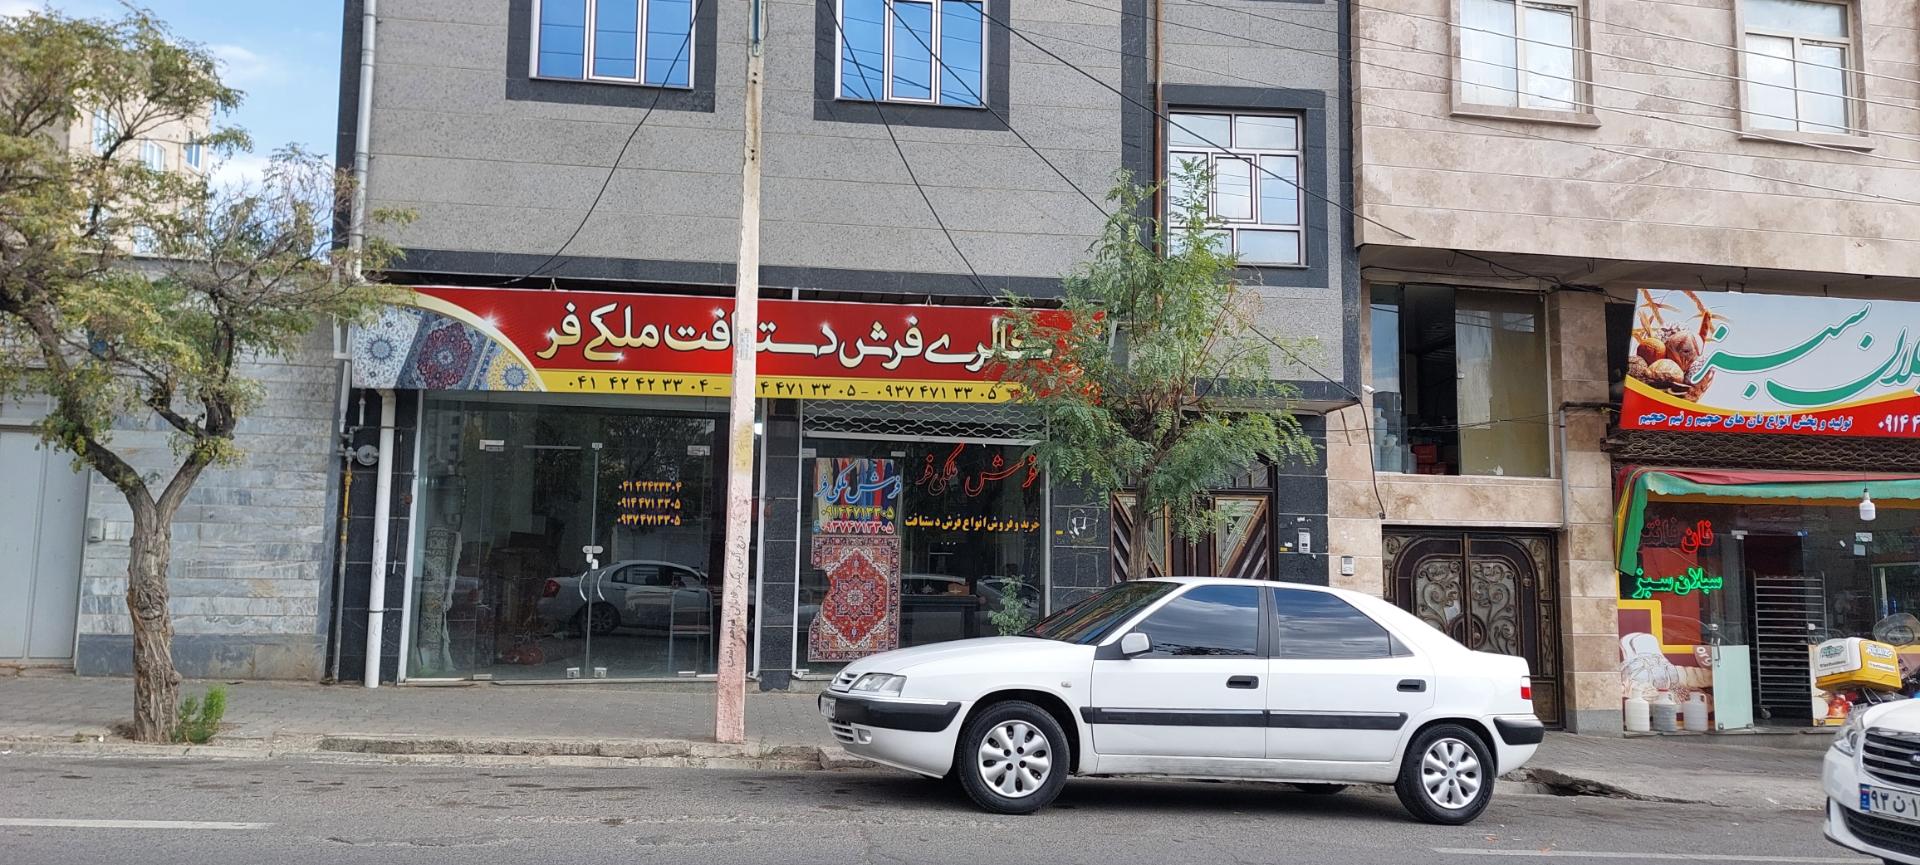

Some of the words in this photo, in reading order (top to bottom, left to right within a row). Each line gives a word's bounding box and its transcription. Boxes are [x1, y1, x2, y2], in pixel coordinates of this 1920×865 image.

[536, 302, 581, 360] فر
[583, 301, 660, 362] ملکی
[838, 317, 923, 370] فرش
[1691, 302, 1872, 400] سبز
[568, 376, 596, 389] ۰۴۱
[609, 377, 630, 391] ۴۲
[635, 378, 656, 391] ۴۲
[662, 378, 683, 392] ۳۳
[689, 379, 709, 393] ۰۴
[776, 381, 804, 396] ۴۷۱
[811, 382, 832, 396] ۳۳
[838, 383, 856, 397] ۰۵
[876, 384, 914, 399] ۰۹۳۷
[920, 385, 948, 399] ۴۷۱
[954, 386, 972, 400] ۳۳
[1638, 412, 1667, 426] حجیم
[1668, 410, 1684, 427] نیم
[1694, 413, 1722, 427] حجیم
[1723, 412, 1746, 428] های
[1746, 413, 1764, 428] نان
[1765, 414, 1792, 429] انواع
[1793, 414, 1818, 431] پخش
[1828, 415, 1854, 432] تولید
[1878, 414, 1909, 433] ۰۹۱۴
[915, 453, 934, 486] فر
[964, 453, 1039, 498] فرش
[814, 474, 829, 498] فر
[844, 471, 903, 504] فرش
[941, 513, 962, 531] فرش
[962, 514, 987, 532] انواع
[1021, 516, 1041, 533] خرید
[1632, 567, 1674, 599] سبز
[1871, 790, 1889, 811] ۹۳
[1893, 795, 1906, 813] ن
